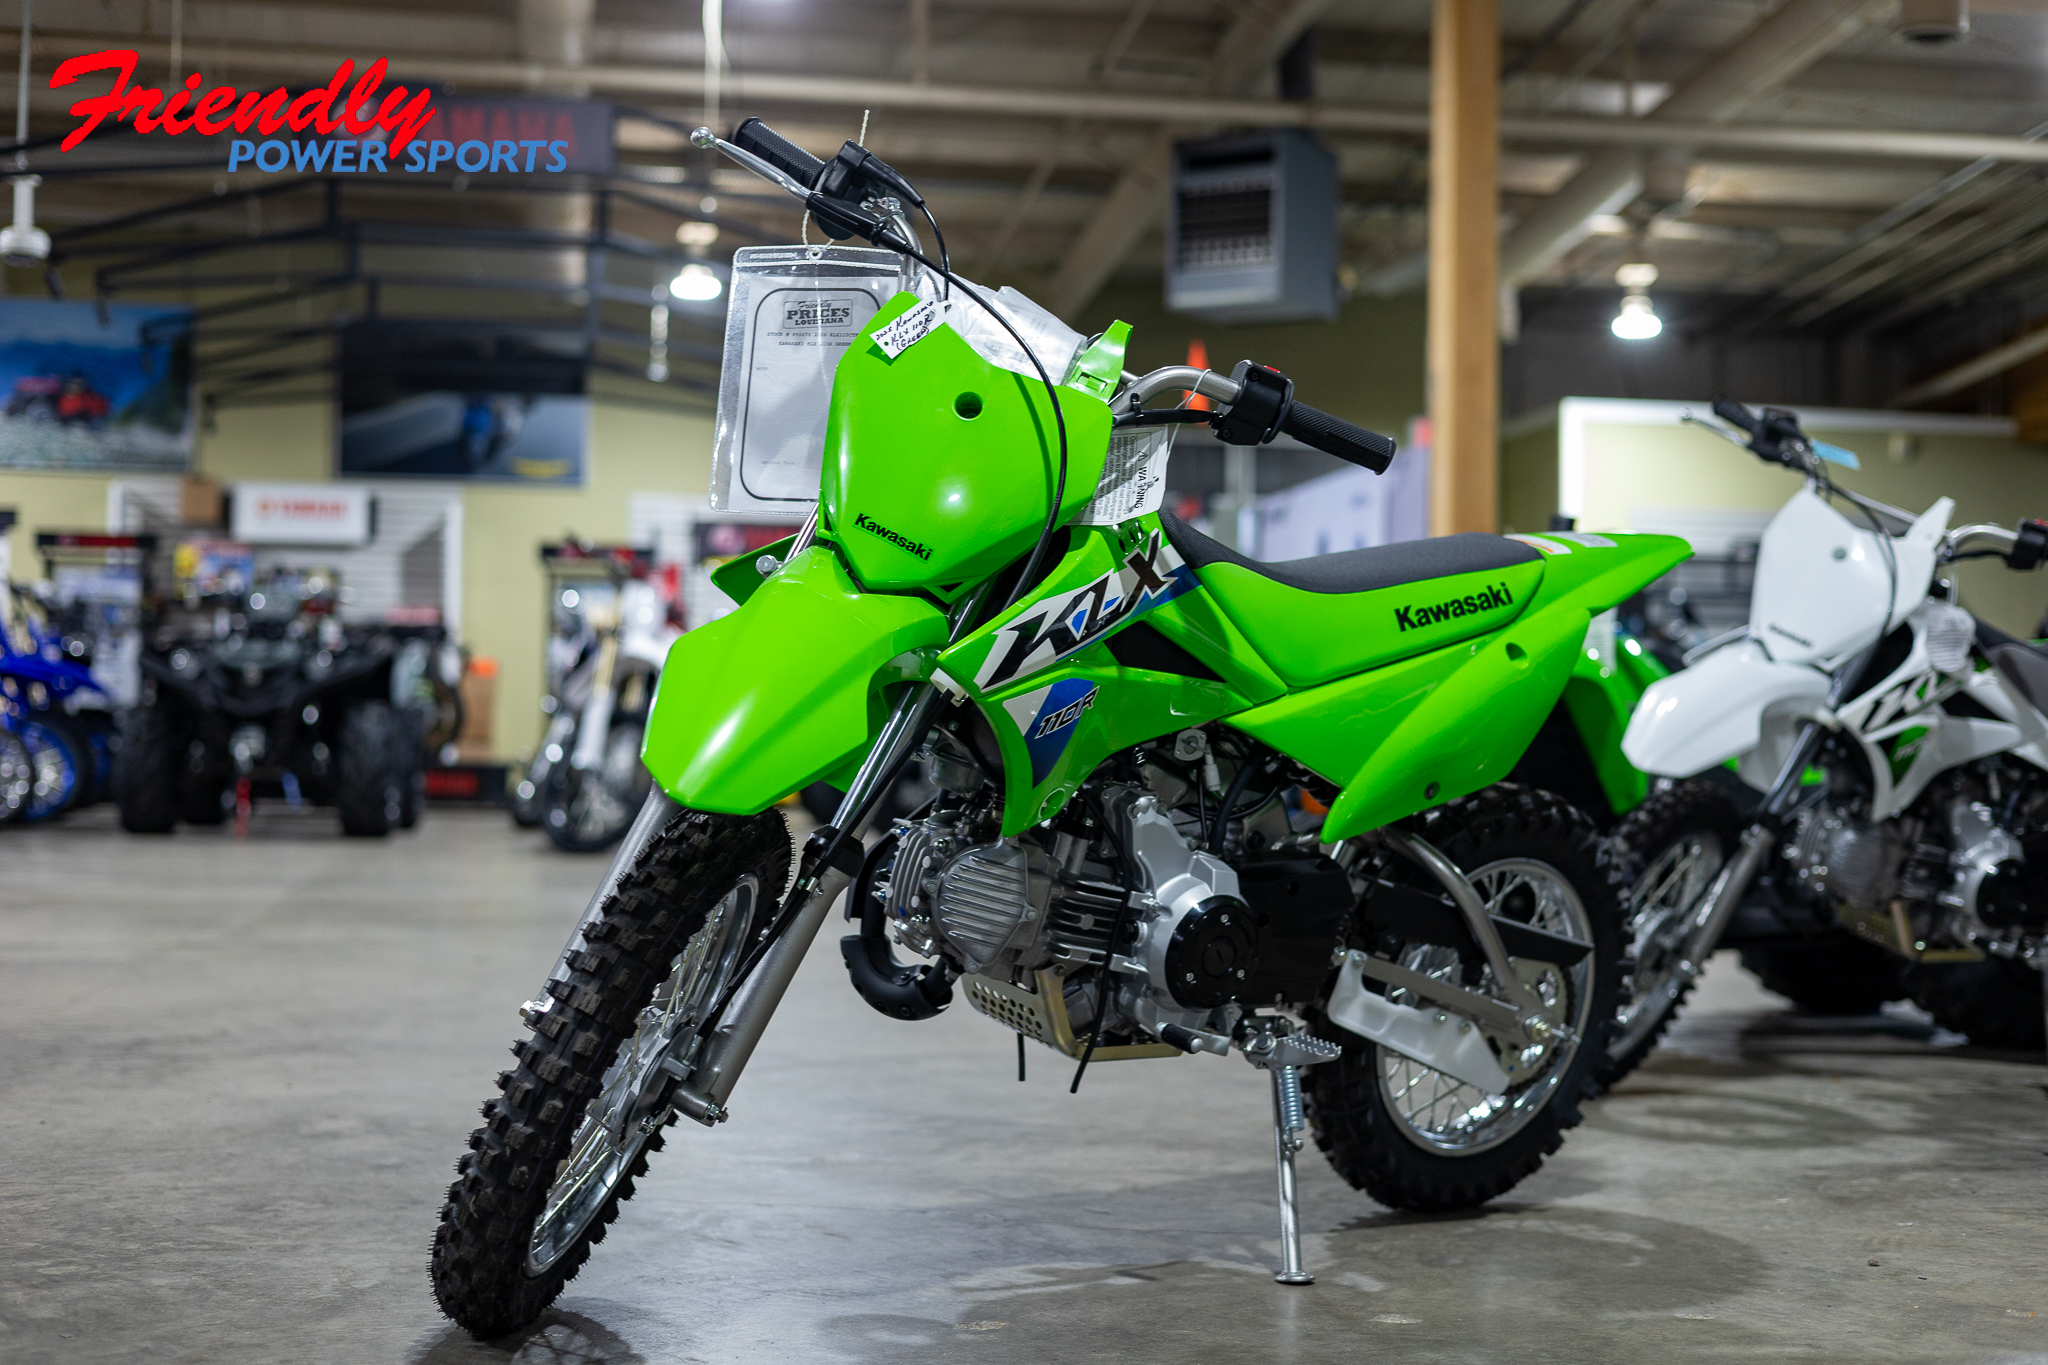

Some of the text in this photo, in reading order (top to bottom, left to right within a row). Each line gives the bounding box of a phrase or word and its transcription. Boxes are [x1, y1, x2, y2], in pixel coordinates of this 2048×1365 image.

[787, 308, 850, 320] PRICES
[891, 327, 909, 346] KLX
[854, 513, 933, 561] Kawasaki
[978, 528, 1178, 693] KLX
[1394, 582, 1514, 632] Kawasaki
[1034, 685, 1100, 739] 110R
